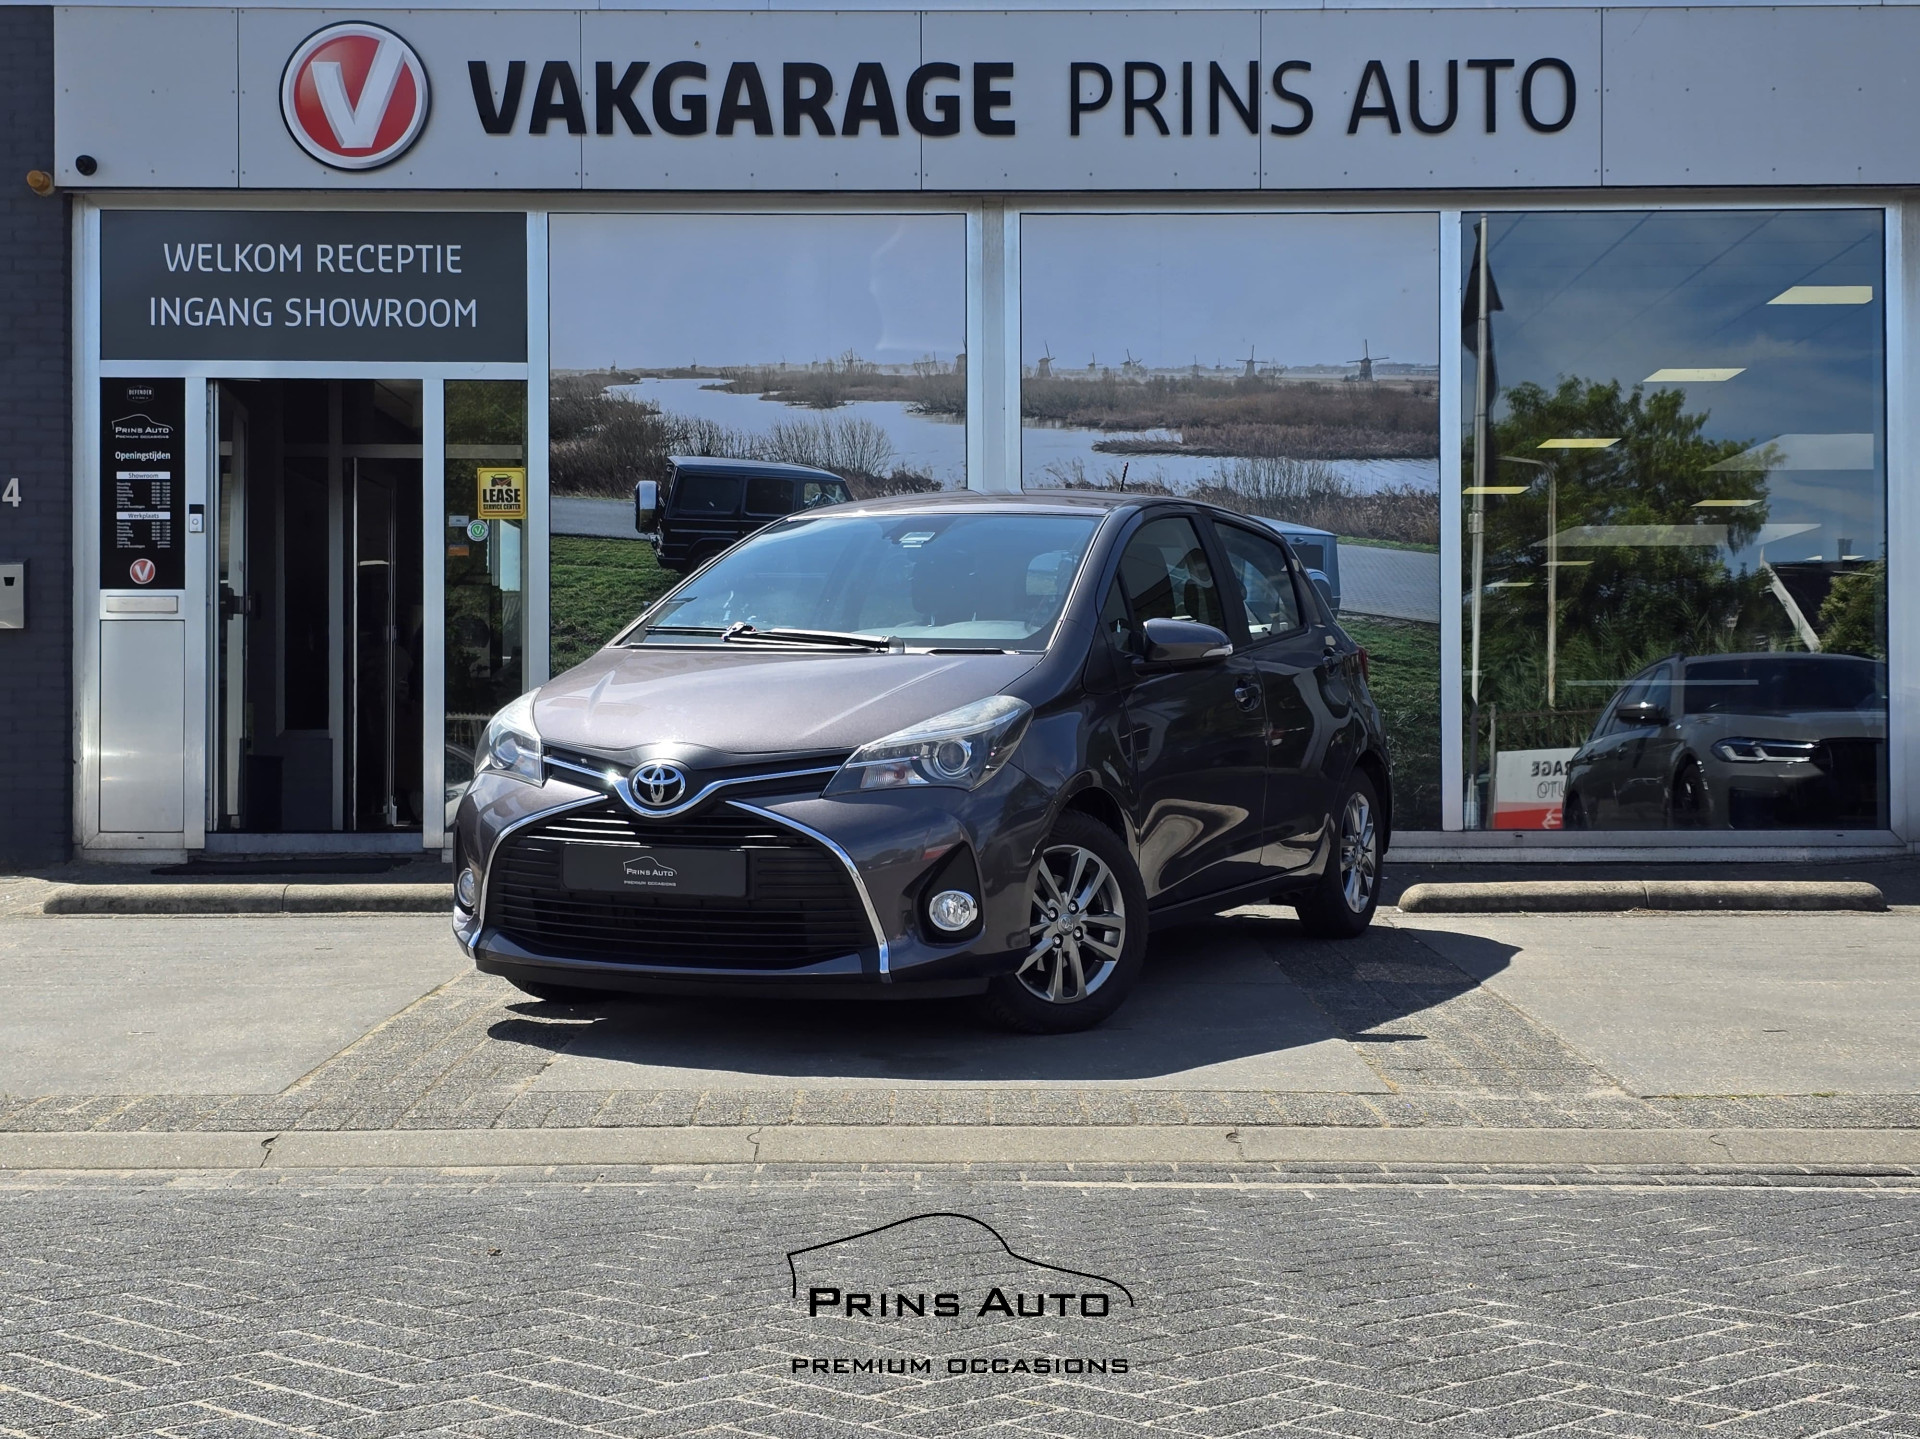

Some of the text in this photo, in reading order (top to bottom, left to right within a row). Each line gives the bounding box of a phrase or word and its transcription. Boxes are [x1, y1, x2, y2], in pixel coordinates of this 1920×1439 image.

[468, 58, 1576, 136] VAKGARAGE PRINS AUTO
[164, 243, 462, 274] WELKOM RECEPTIE
[150, 297, 477, 328] INGANG SHOWROOM
[115, 426, 169, 434] PRINS AUTO
[115, 451, 171, 462] Openingstijden
[2, 477, 22, 507] 4
[482, 488, 521, 503] LEASE
[626, 868, 674, 877] PRINS AUTO
